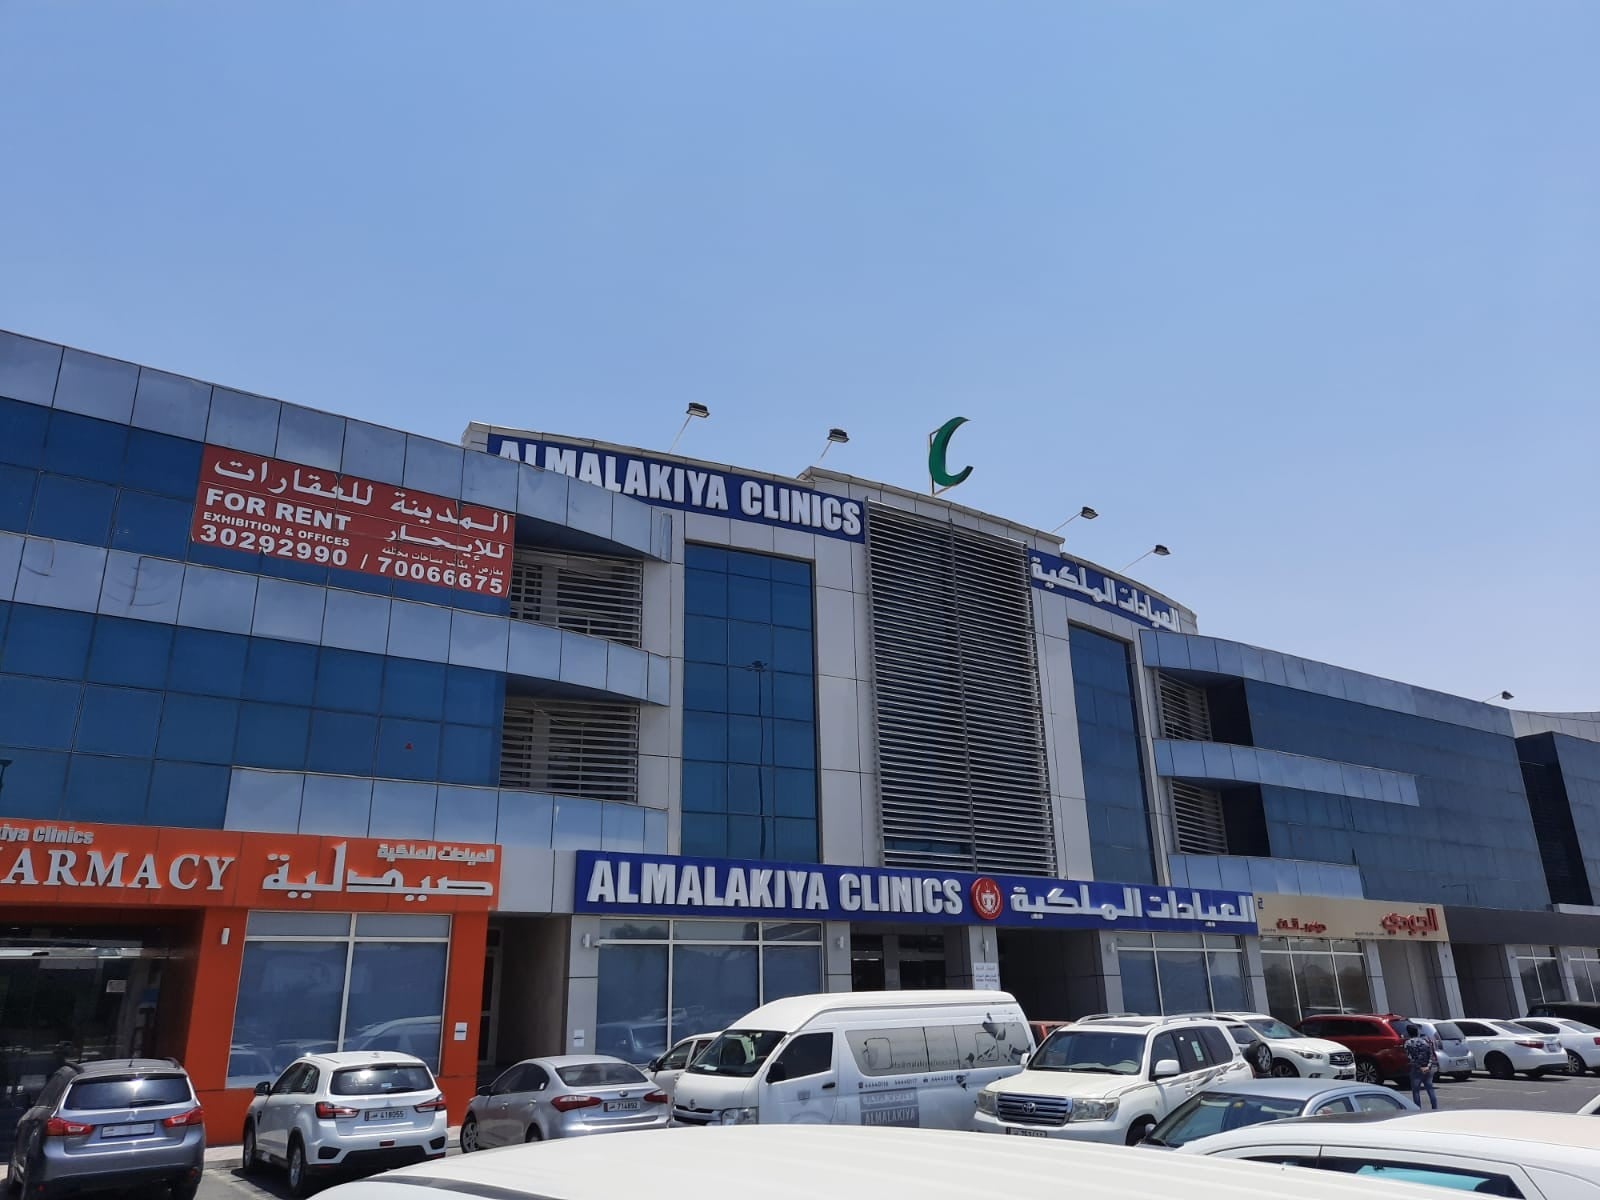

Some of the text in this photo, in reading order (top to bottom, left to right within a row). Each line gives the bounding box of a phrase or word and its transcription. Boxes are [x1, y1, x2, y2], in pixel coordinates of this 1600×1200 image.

[205, 487, 351, 531] FOR RENT
[214, 461, 508, 534] المدينة للعقارات
[740, 480, 861, 536] CLINICS
[203, 511, 350, 547] EXHIBITION & OFFICES
[200, 524, 503, 594] 30292990 / 70066675
[1030, 556, 1181, 633] العيادات الملكية
[33, 825, 94, 845] Clinics
[376, 843, 436, 862] الملكية
[0, 846, 236, 890] ARMACY
[263, 840, 493, 902] صيدلية
[586, 860, 963, 915] ALMALAKIYA CLINICS
[1010, 884, 1256, 928] العيادات الملكية
